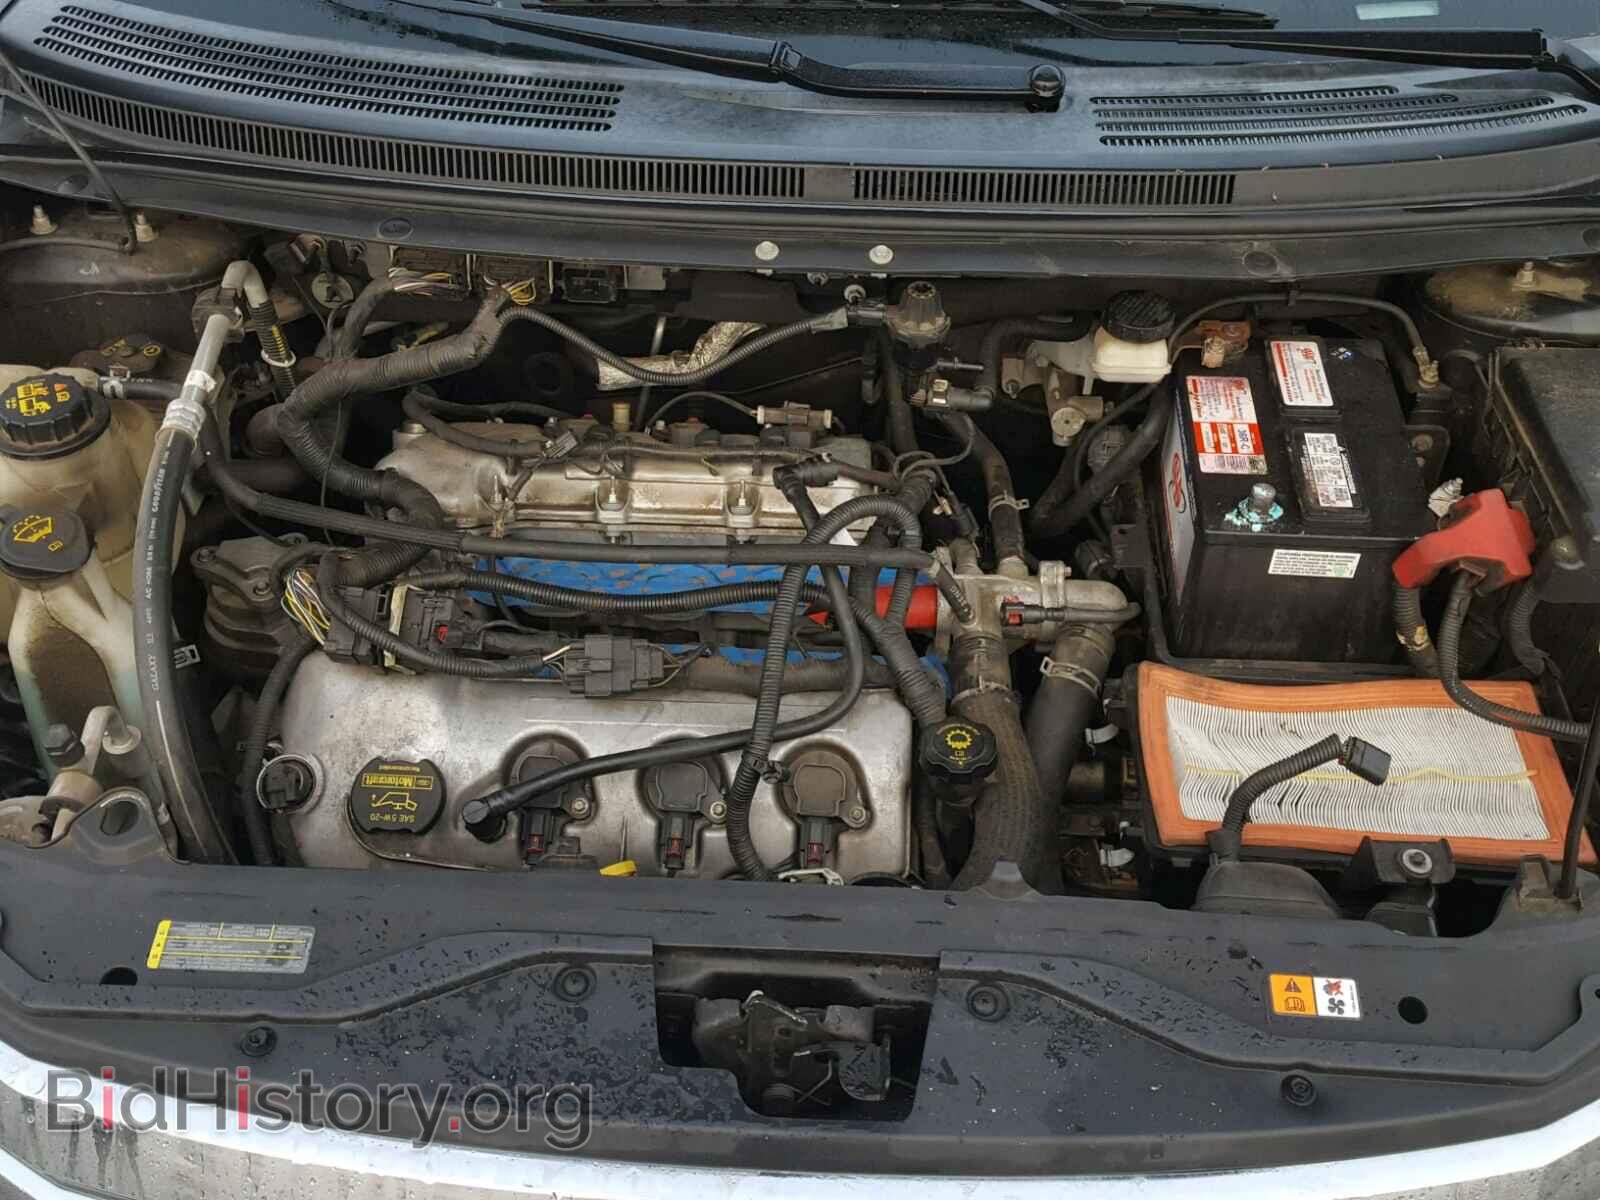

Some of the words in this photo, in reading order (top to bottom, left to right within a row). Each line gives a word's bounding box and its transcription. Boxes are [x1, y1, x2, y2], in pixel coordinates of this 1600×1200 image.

[152, 469, 165, 512] GOODYEAR
[366, 775, 413, 787] Motorcraft
[399, 814, 415, 823] SAE
